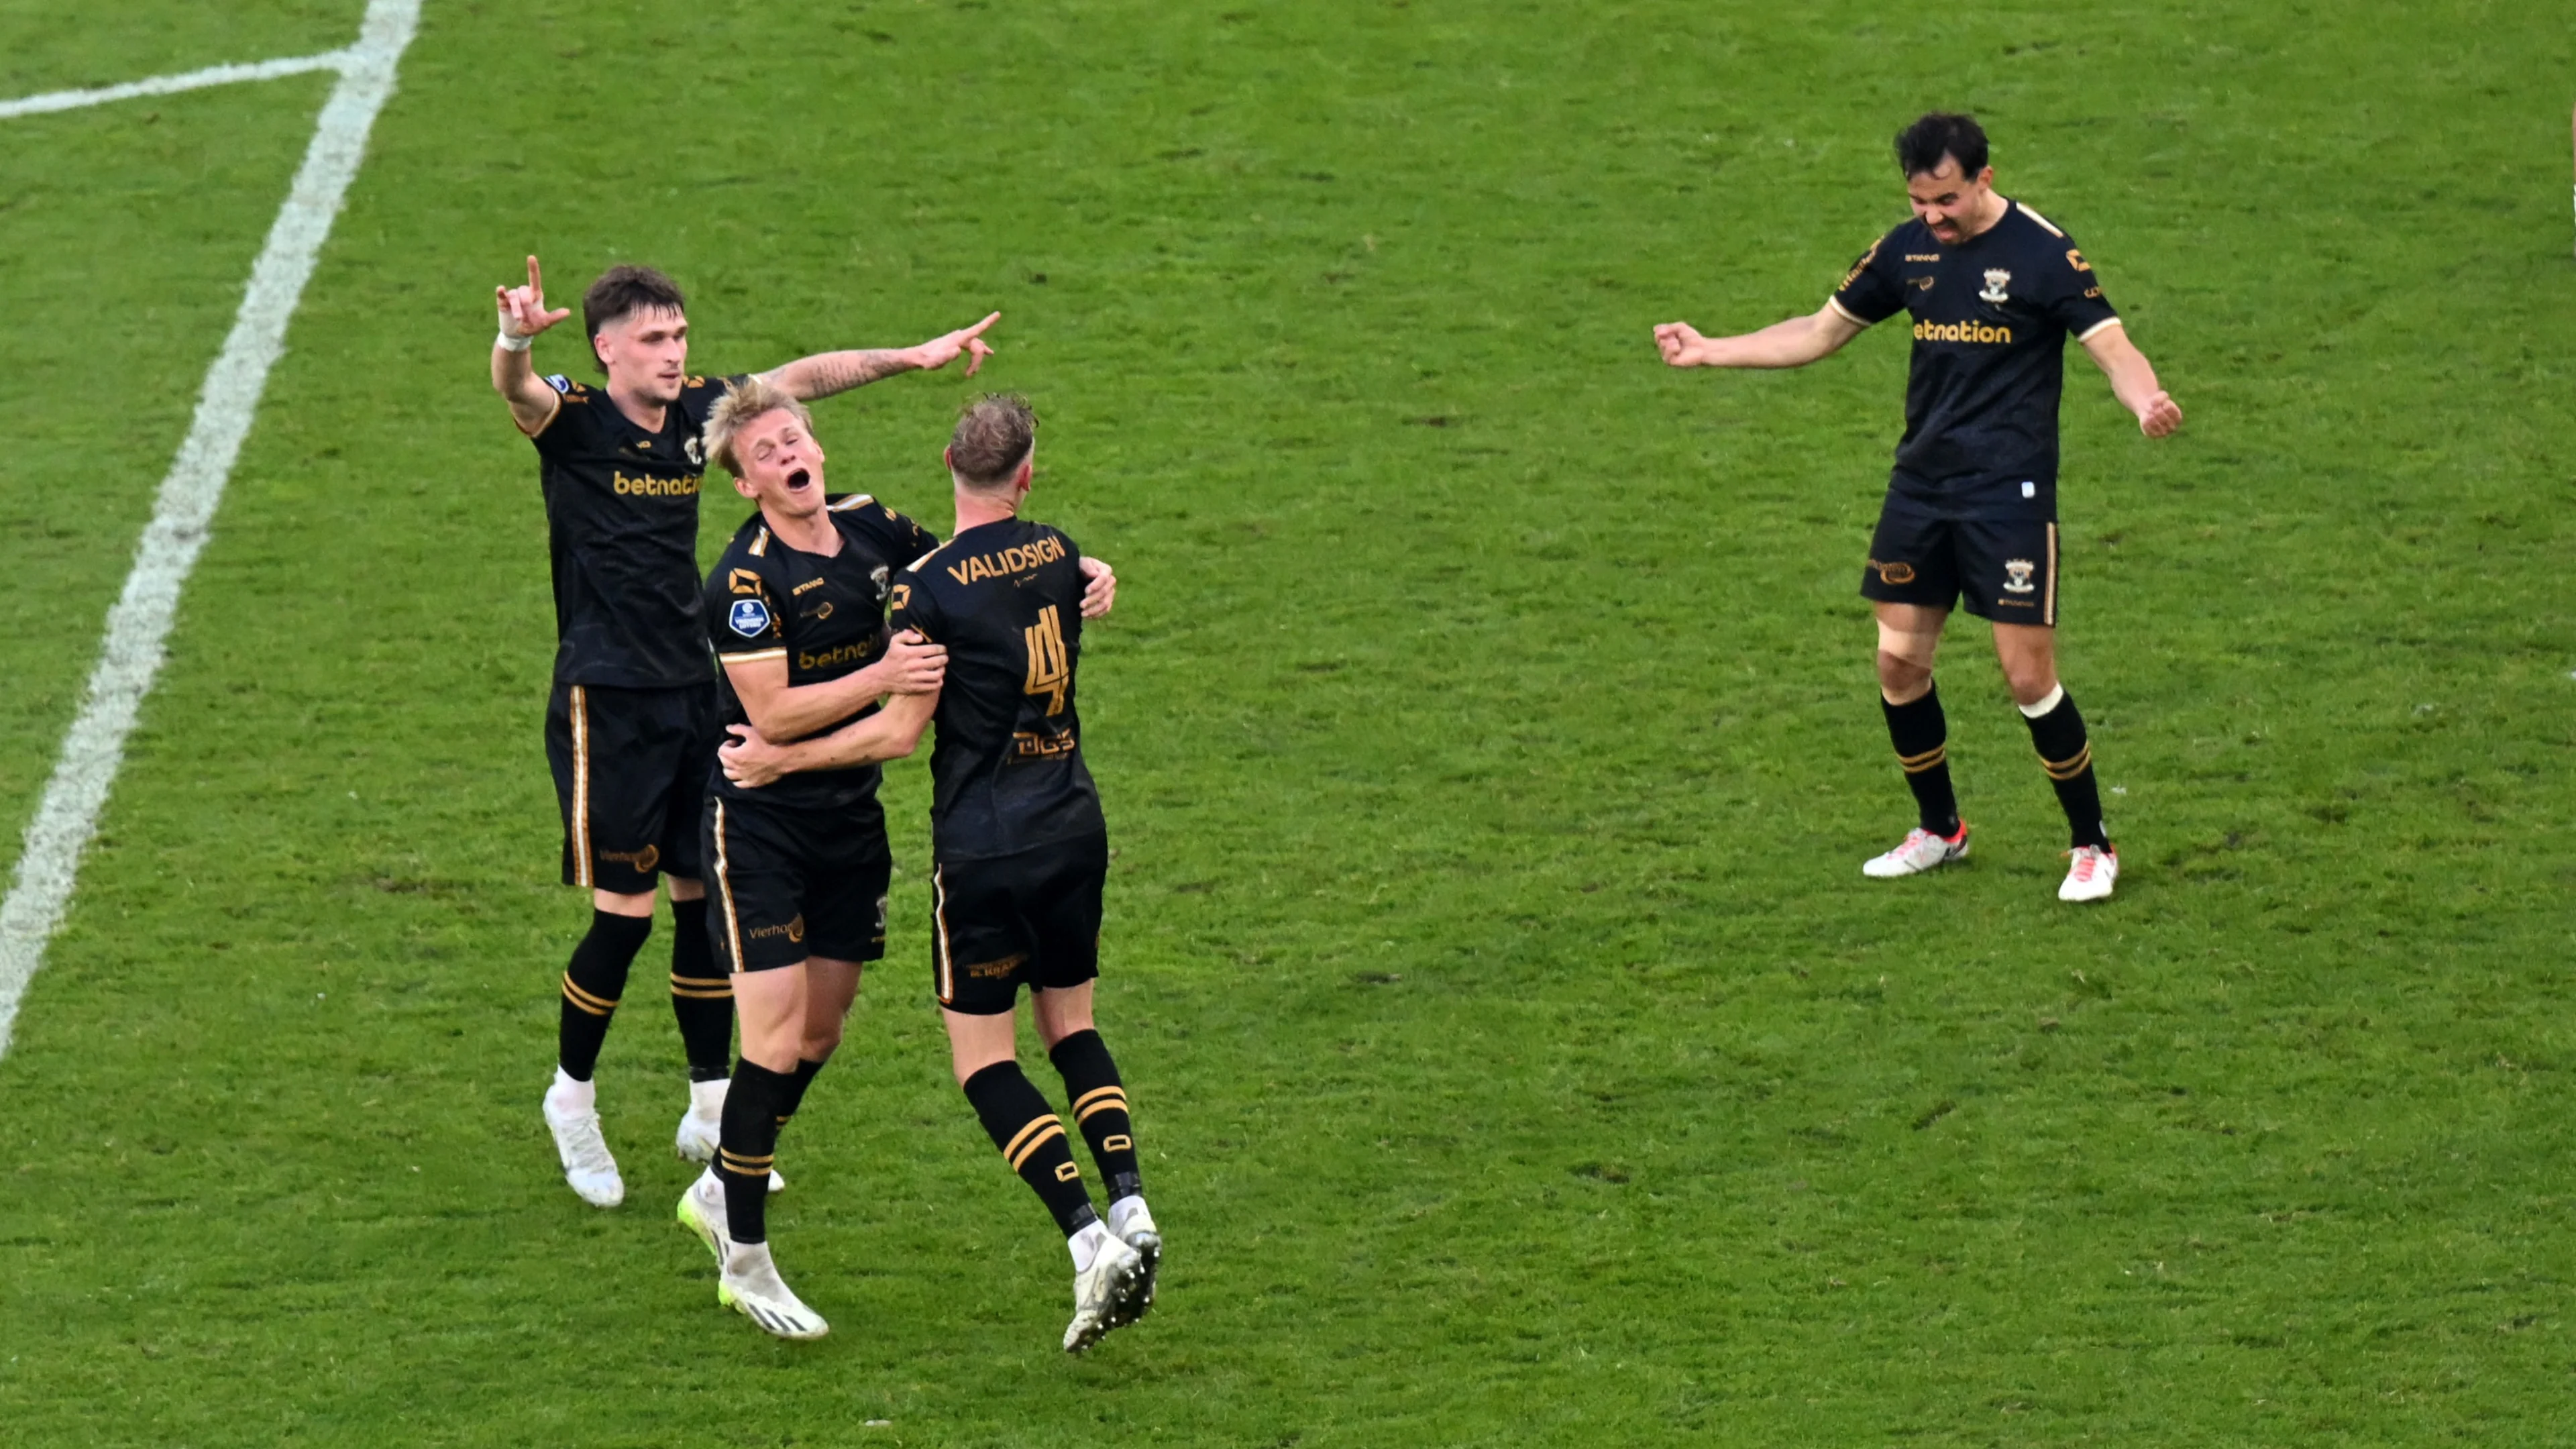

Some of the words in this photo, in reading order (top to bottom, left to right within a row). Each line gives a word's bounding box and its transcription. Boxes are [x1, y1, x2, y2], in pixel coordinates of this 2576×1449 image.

[1913, 319, 2012, 344] etnation
[947, 535, 1066, 586] VALIDSIGN
[1024, 604, 1069, 717] 4
[749, 924, 792, 940] Vierho
